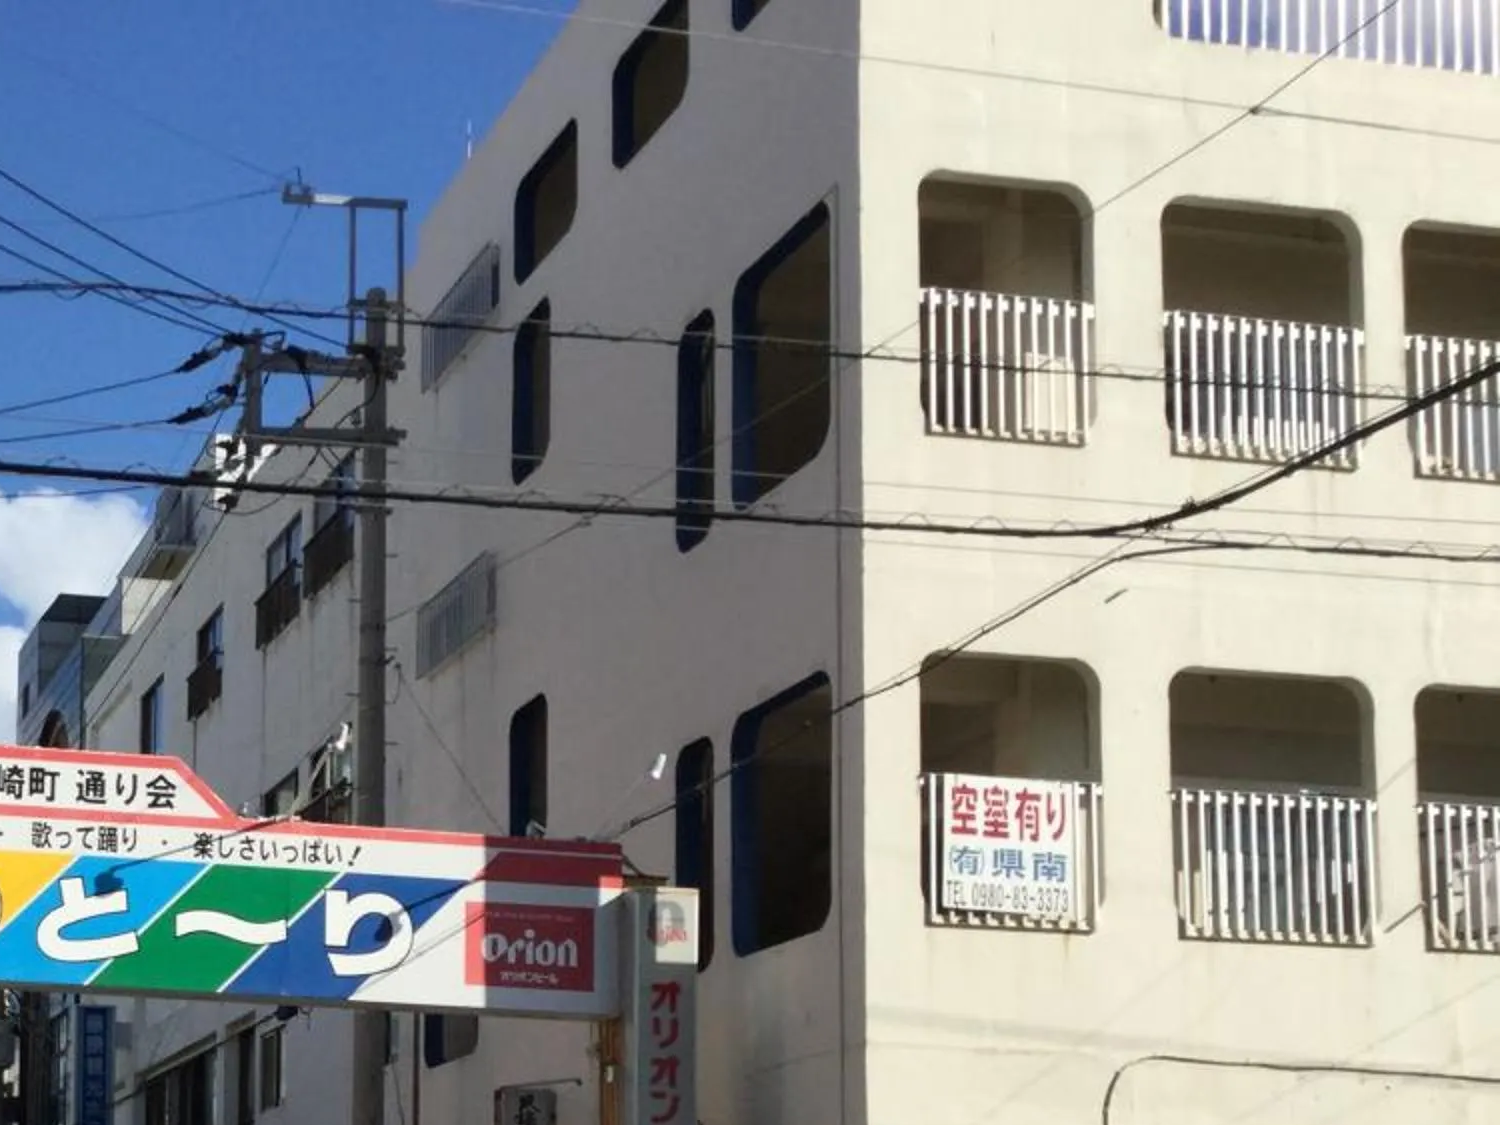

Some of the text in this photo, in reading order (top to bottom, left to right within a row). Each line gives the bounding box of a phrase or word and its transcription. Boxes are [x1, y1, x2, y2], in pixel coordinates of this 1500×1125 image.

[76, 768, 177, 809] 通り会
[950, 784, 1067, 842] 空室有り
[30, 821, 138, 853] 歌って踊り
[480, 928, 580, 969] Orion
